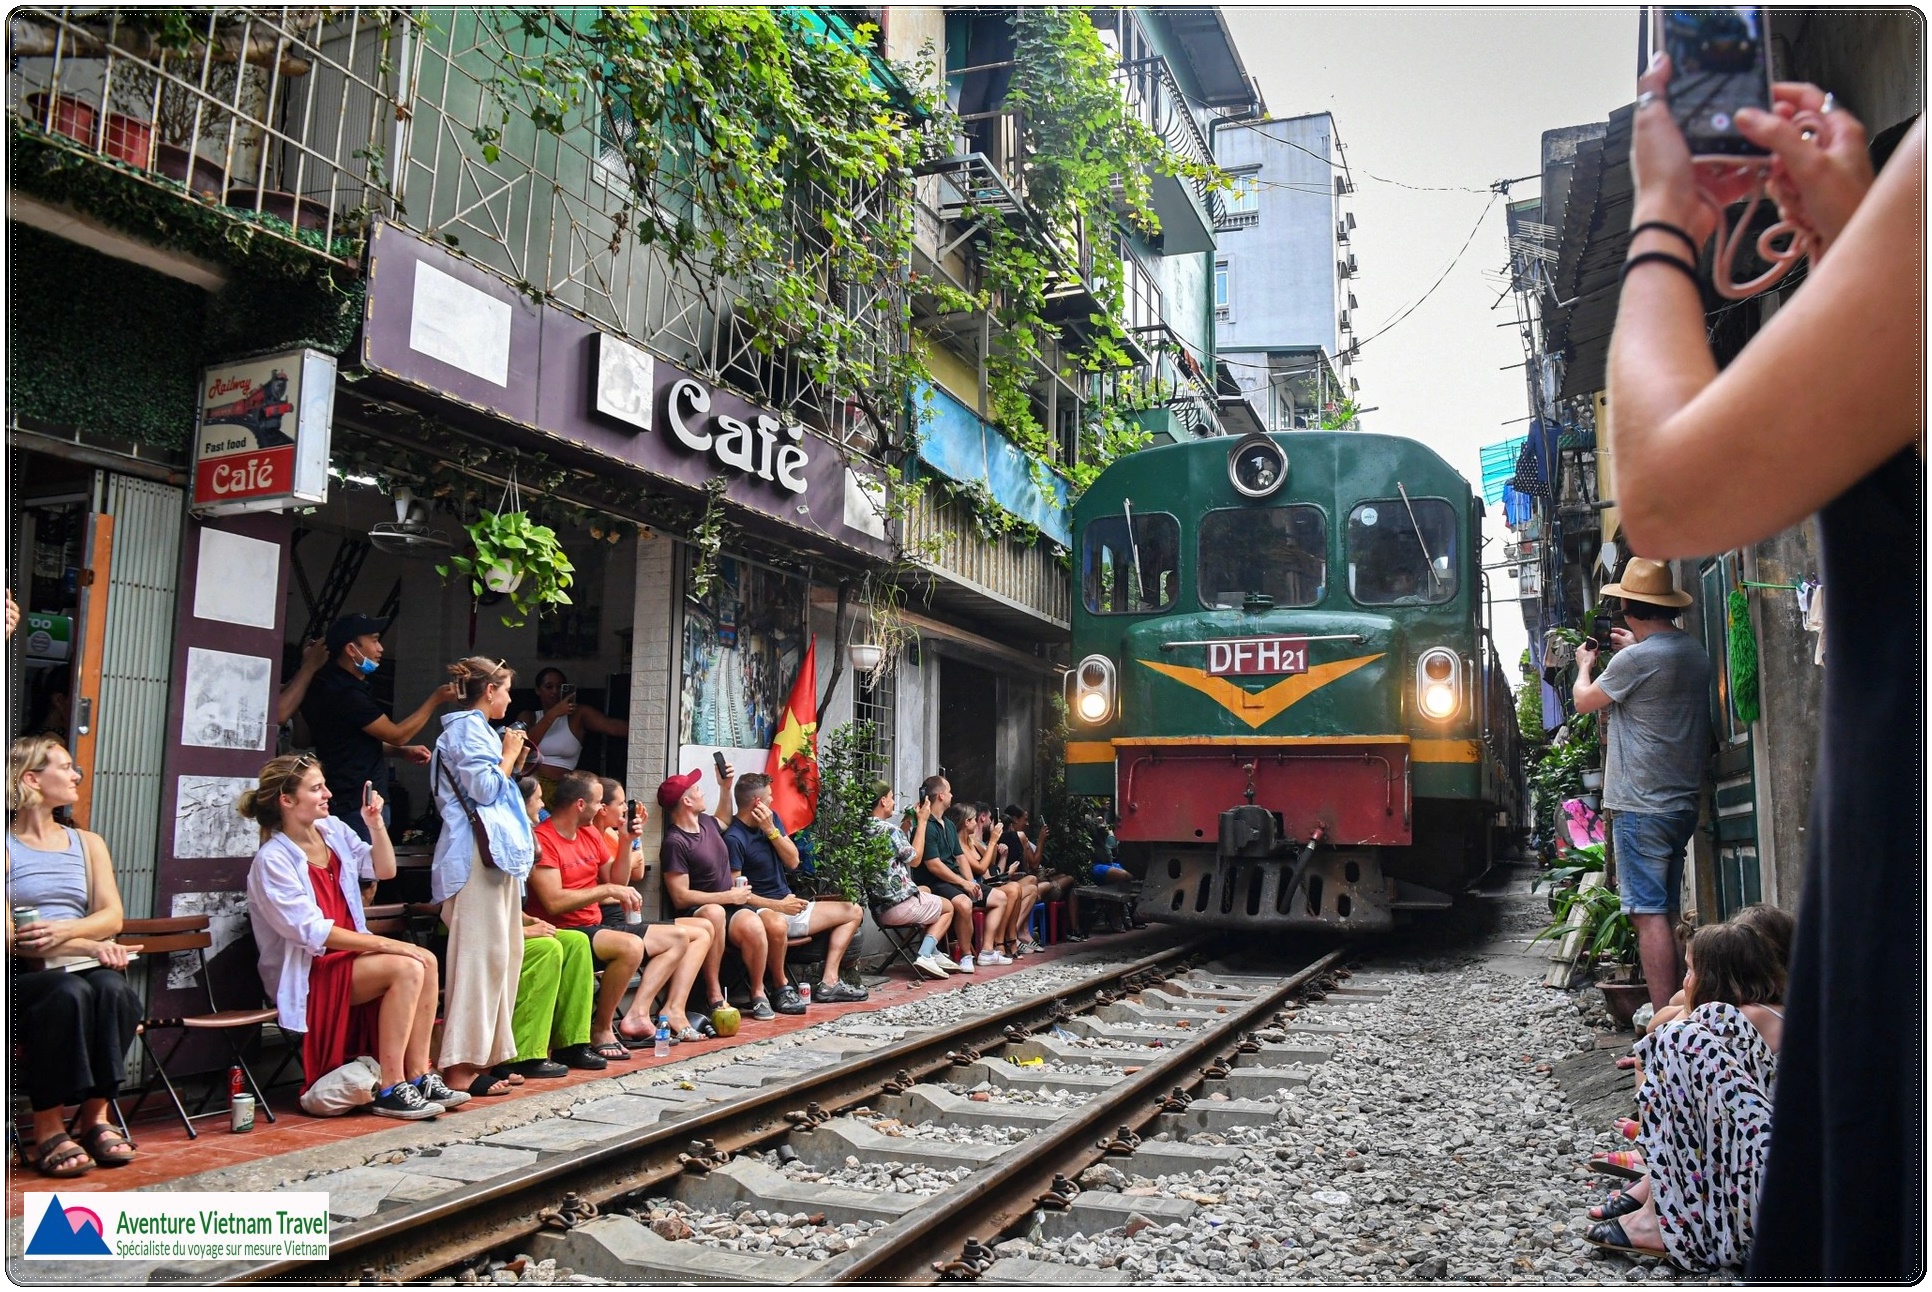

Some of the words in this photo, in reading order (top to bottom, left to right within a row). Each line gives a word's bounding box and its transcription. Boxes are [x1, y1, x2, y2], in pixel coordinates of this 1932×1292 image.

[209, 375, 251, 398] Railway
[205, 441, 224, 454] Fast
[227, 437, 247, 451] food
[668, 378, 809, 494] Café
[212, 458, 273, 494] Café
[1209, 641, 1304, 673] DFH21
